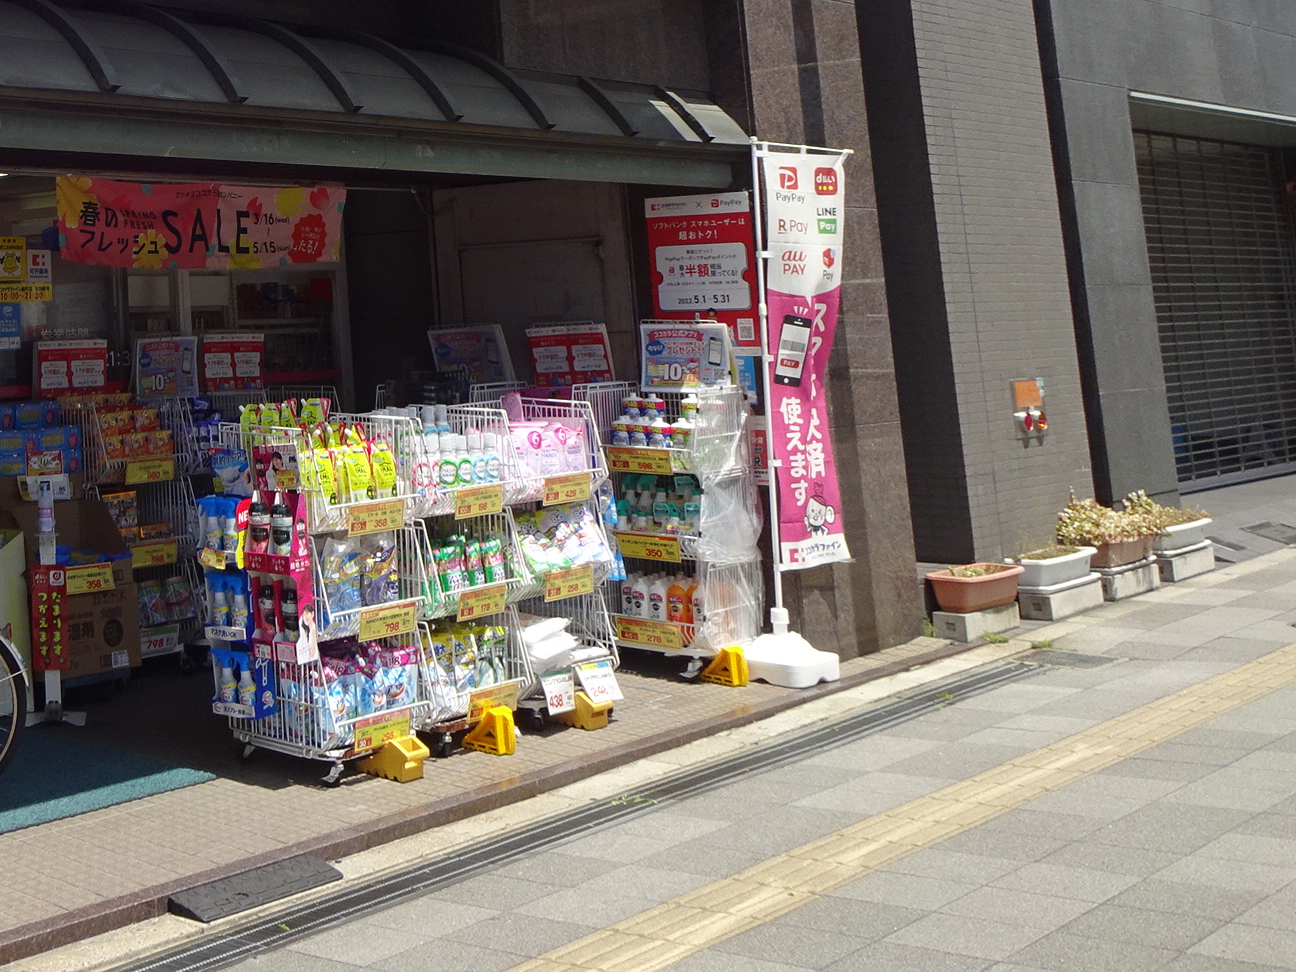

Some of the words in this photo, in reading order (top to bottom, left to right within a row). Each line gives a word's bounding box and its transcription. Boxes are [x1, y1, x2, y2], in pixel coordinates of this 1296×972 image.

[776, 192, 805, 203] PayPay
[79, 201, 118, 228] 春の
[120, 209, 157, 220] SPRING
[817, 208, 836, 216] LINE
[124, 219, 155, 230] FRESH
[790, 219, 808, 235] Pay
[819, 221, 835, 231] Pay
[162, 209, 251, 254] SALE
[79, 229, 160, 254] フレッシュ
[782, 250, 806, 262] au
[685, 264, 710, 277] 半額
[783, 263, 806, 275] PAY
[823, 270, 834, 282] Pay
[780, 397, 808, 507] 使えます
[645, 548, 662, 558] 350
[87, 580, 101, 589] 358
[38, 592, 50, 663] つかえます。
[52, 592, 64, 663] たまります。
[385, 622, 399, 633] 798
[646, 634, 662, 644] 278
[549, 694, 564, 708] 438
